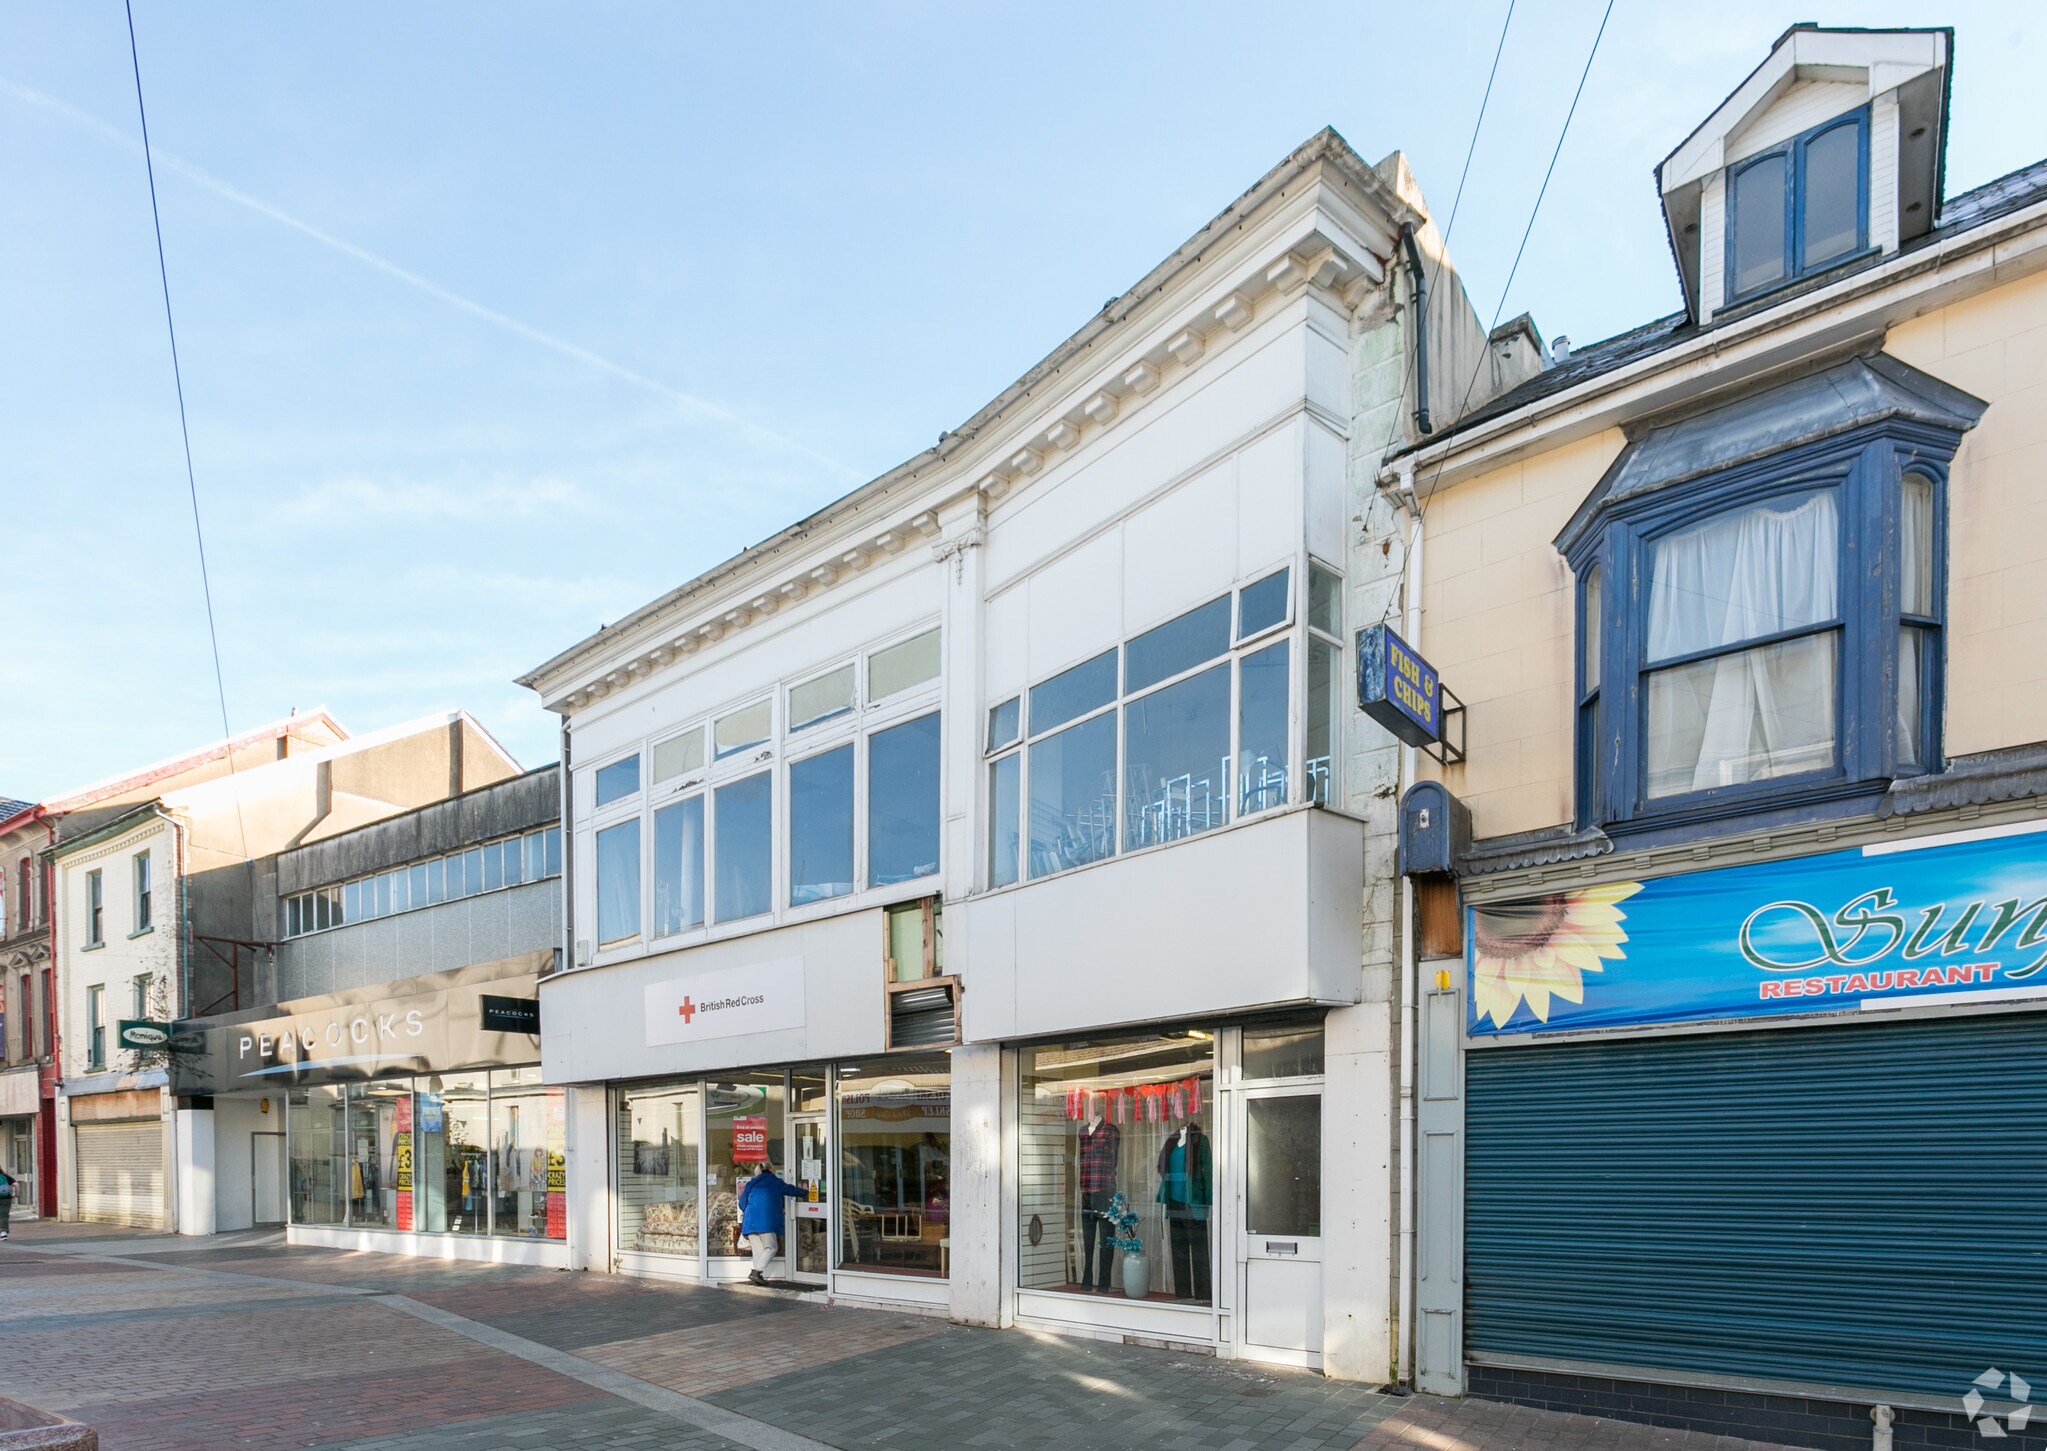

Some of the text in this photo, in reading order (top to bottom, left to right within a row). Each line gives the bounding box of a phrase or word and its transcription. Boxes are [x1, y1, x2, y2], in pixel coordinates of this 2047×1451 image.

[1390, 642, 1434, 698] FISH &
[1394, 676, 1431, 723] CHIPS
[1738, 886, 2047, 980] Sun
[1760, 963, 2001, 999] RESTAURANT
[489, 1009, 534, 1018] PEACOCKS
[700, 994, 764, 1013] British Red Cross
[240, 1010, 423, 1059] PEACOCKS
[736, 1131, 764, 1143] sale
[398, 1149, 412, 1168] £3
